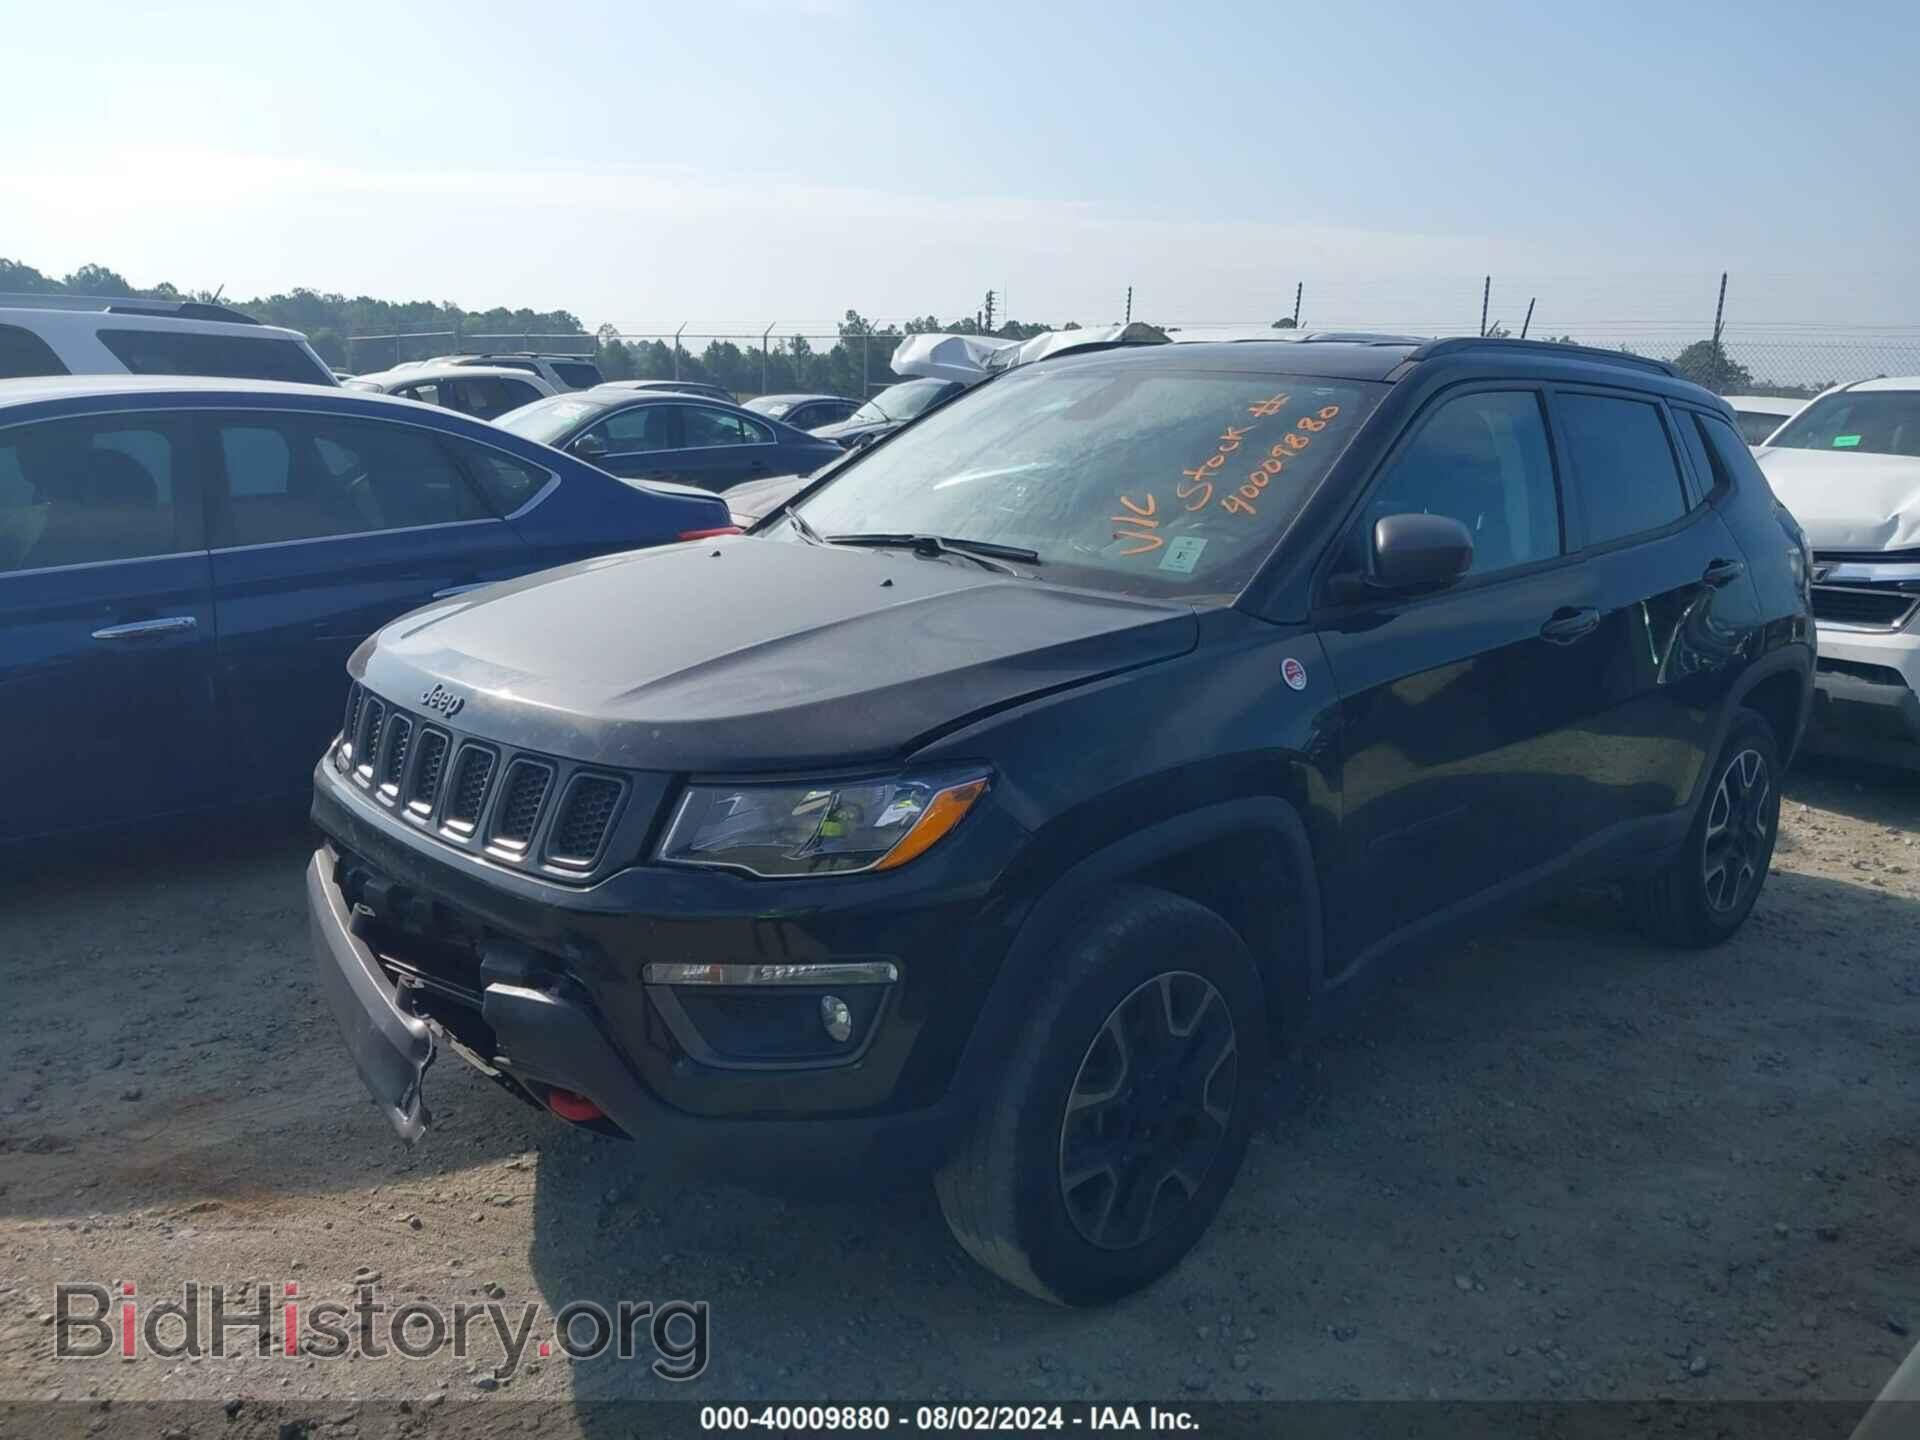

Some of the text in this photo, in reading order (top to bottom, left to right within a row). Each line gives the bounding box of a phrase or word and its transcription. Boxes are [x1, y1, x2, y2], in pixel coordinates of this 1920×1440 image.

[1248, 392, 1291, 417] #
[1221, 405, 1340, 515] 40009880
[420, 682, 464, 718] Jeep
